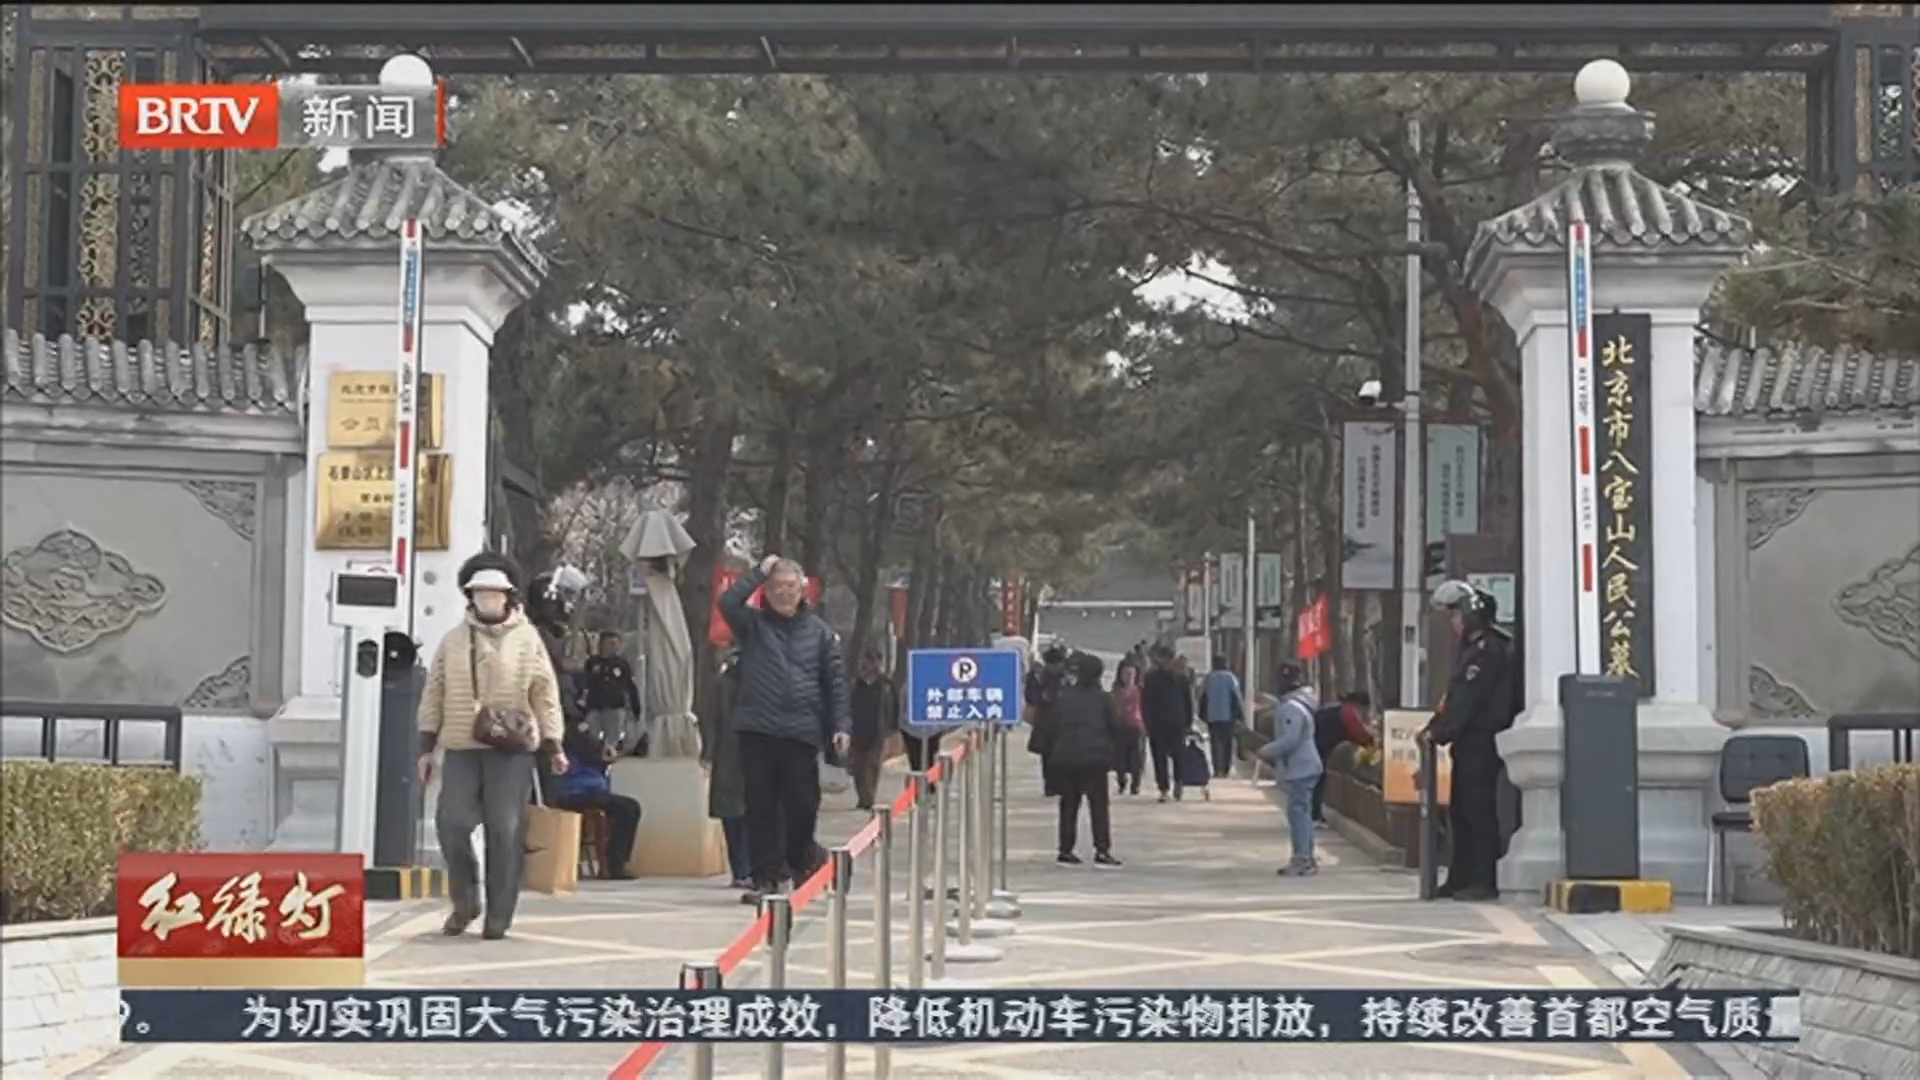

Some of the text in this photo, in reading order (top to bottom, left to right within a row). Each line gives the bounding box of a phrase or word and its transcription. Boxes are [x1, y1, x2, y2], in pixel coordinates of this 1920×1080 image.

[1601, 335, 1639, 678] 北京市八宝山人民公墓
[926, 687, 1004, 703] 外部车辆
